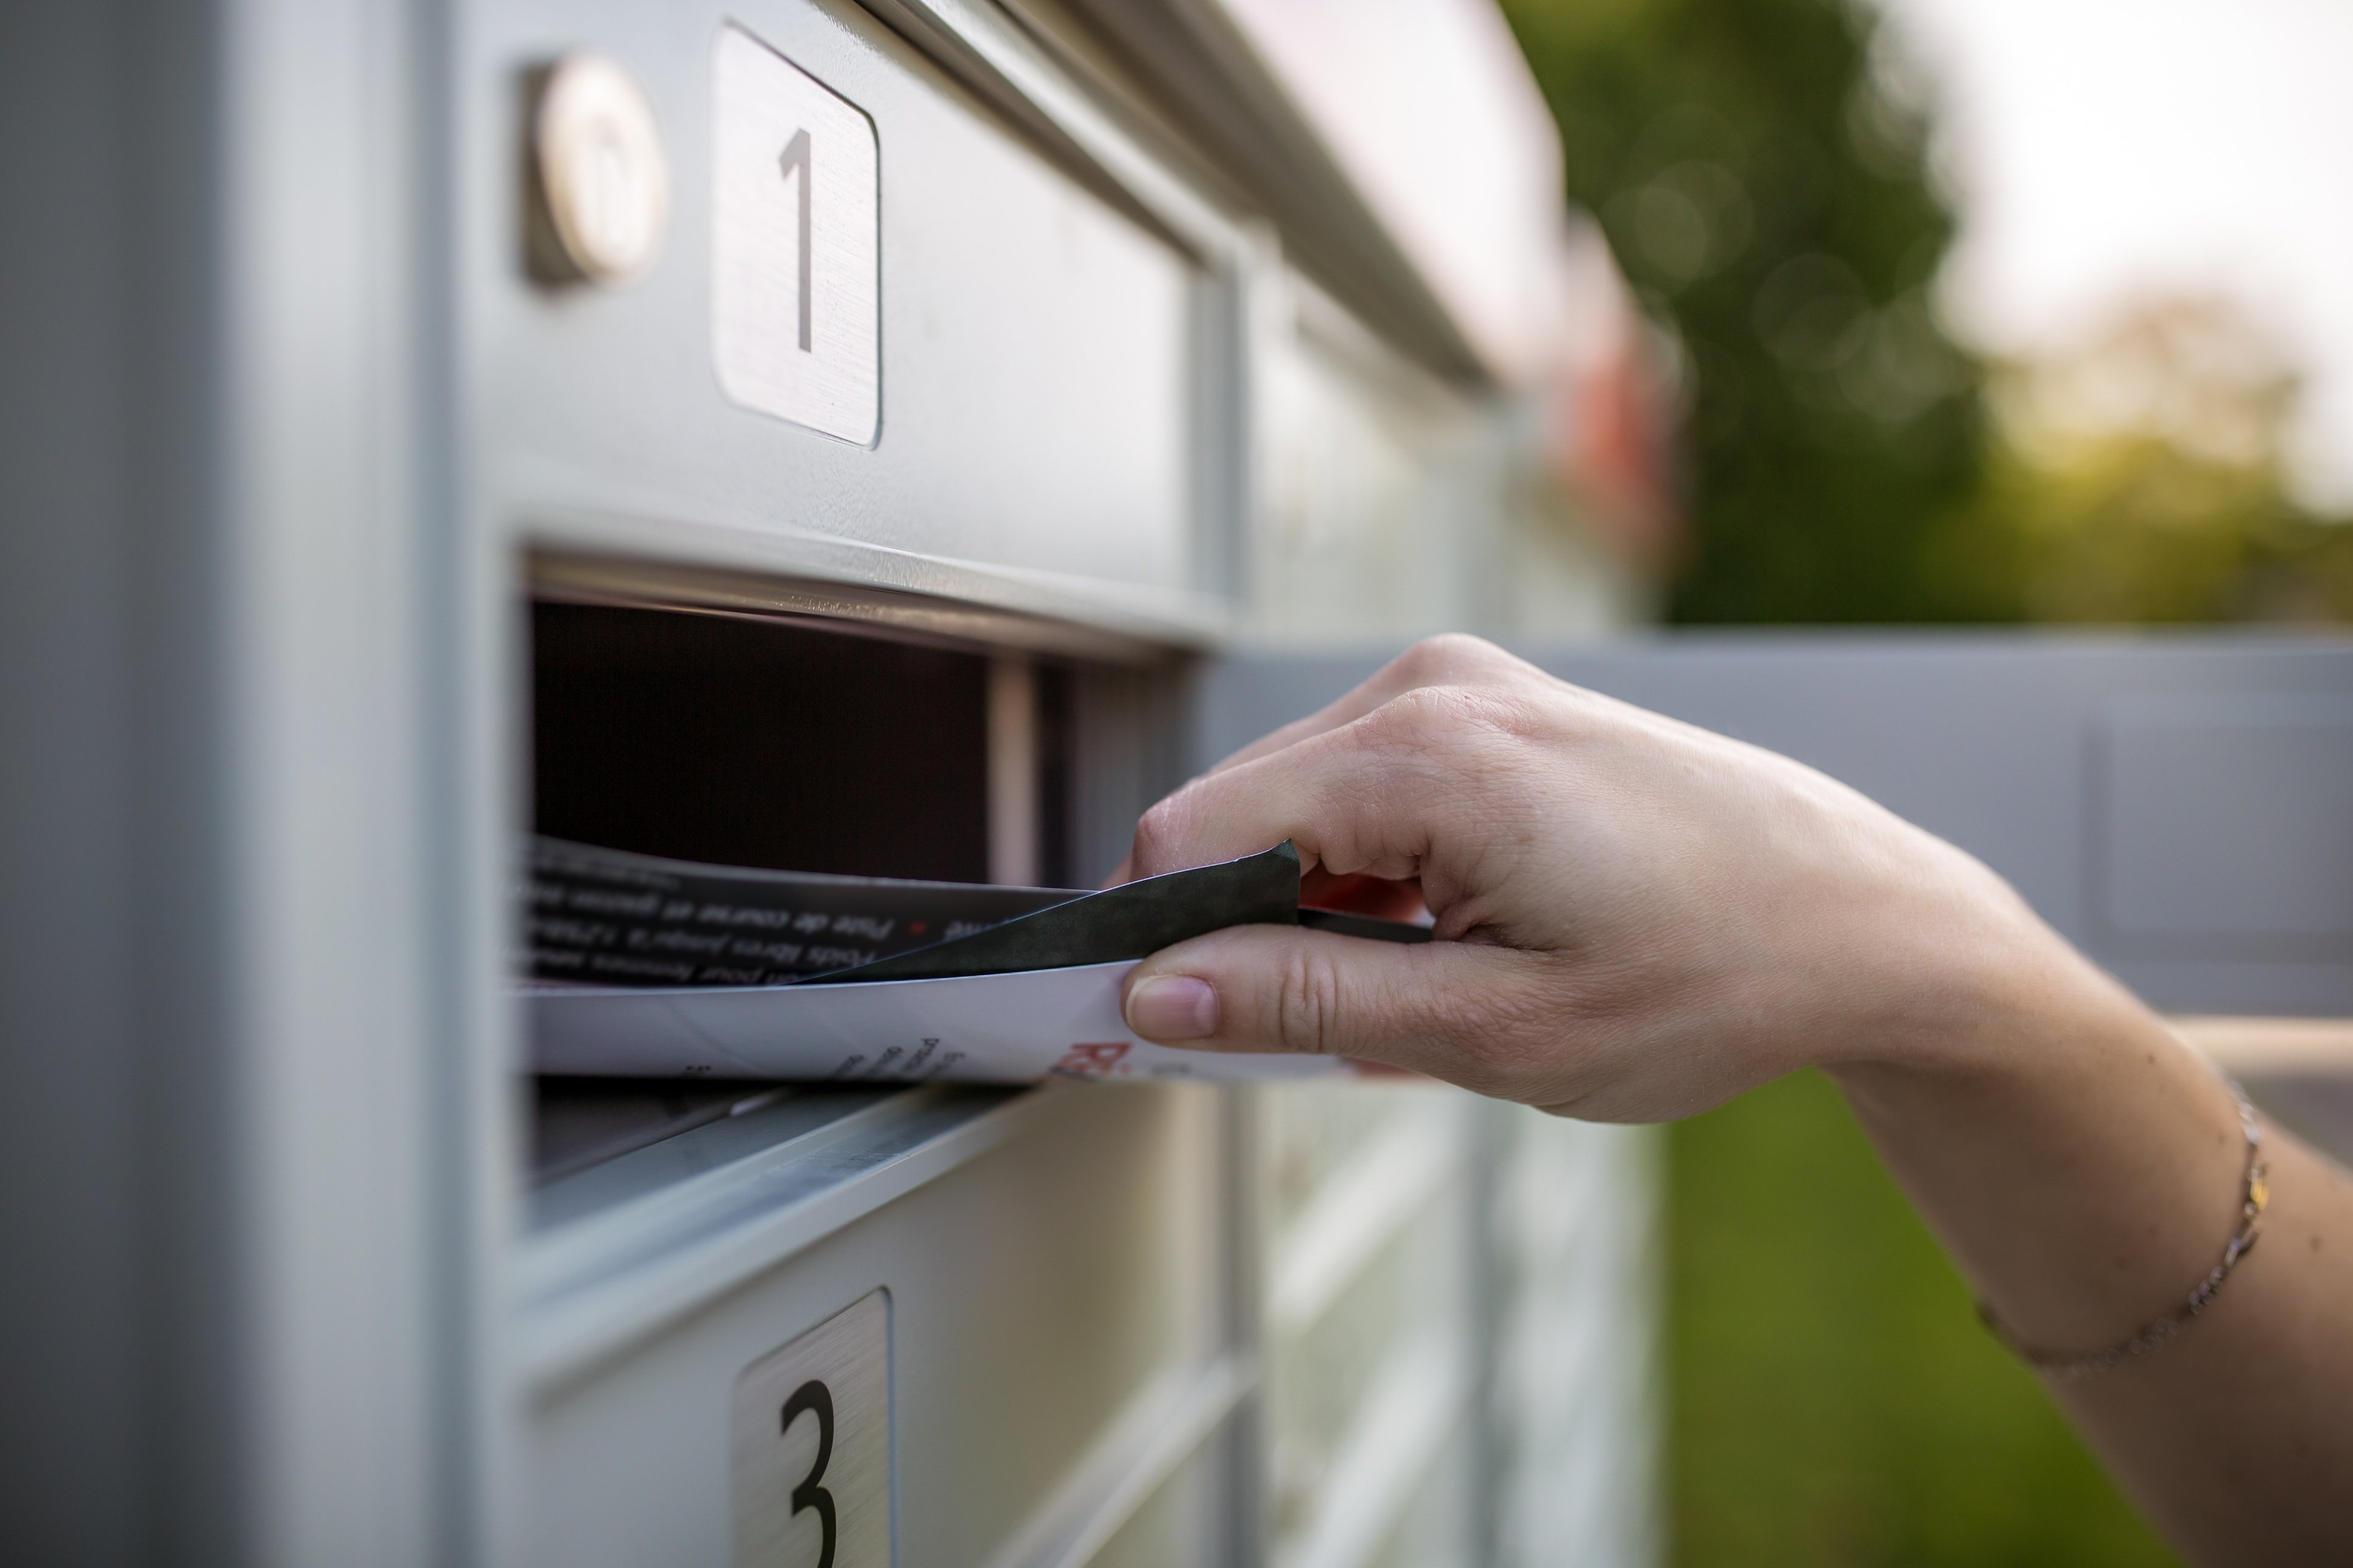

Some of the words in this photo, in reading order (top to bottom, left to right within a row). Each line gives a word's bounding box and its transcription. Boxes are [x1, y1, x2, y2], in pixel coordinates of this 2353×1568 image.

[779, 128, 811, 354] 1
[698, 905, 790, 926] course
[794, 913, 829, 934] de
[833, 917, 896, 940] Piste
[780, 1379, 836, 1568] 3
